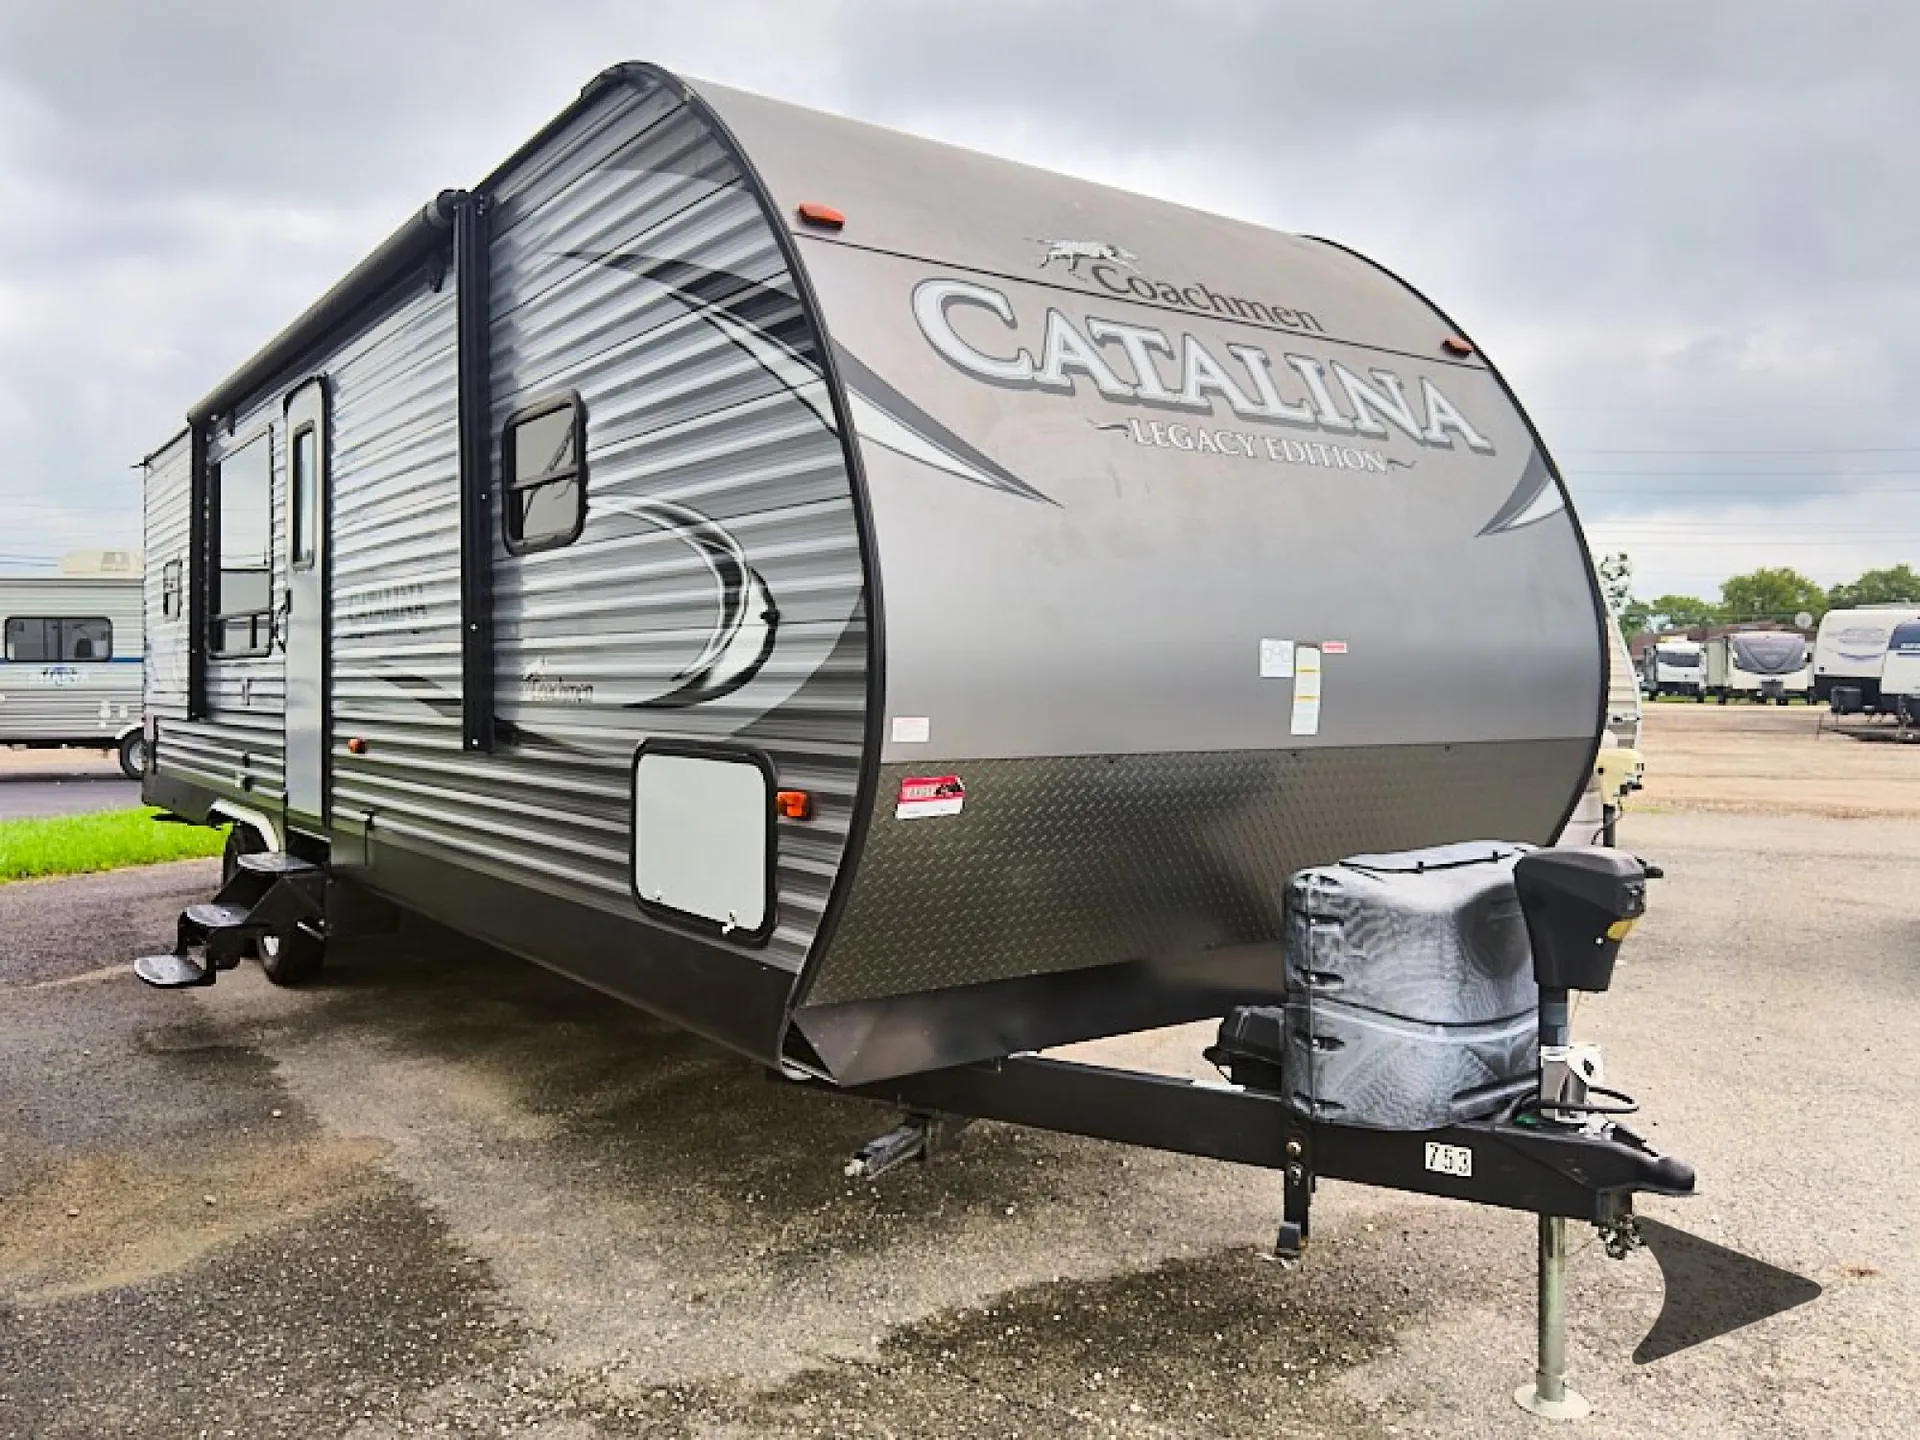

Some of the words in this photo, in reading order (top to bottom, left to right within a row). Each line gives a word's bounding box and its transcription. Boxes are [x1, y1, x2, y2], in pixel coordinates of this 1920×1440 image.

[1093, 265, 1325, 332] Coachmen
[911, 277, 1496, 455] CATALINA
[1128, 417, 1256, 458] LEGACY
[1263, 436, 1388, 474] EDITION
[1428, 1144, 1470, 1174] 753
